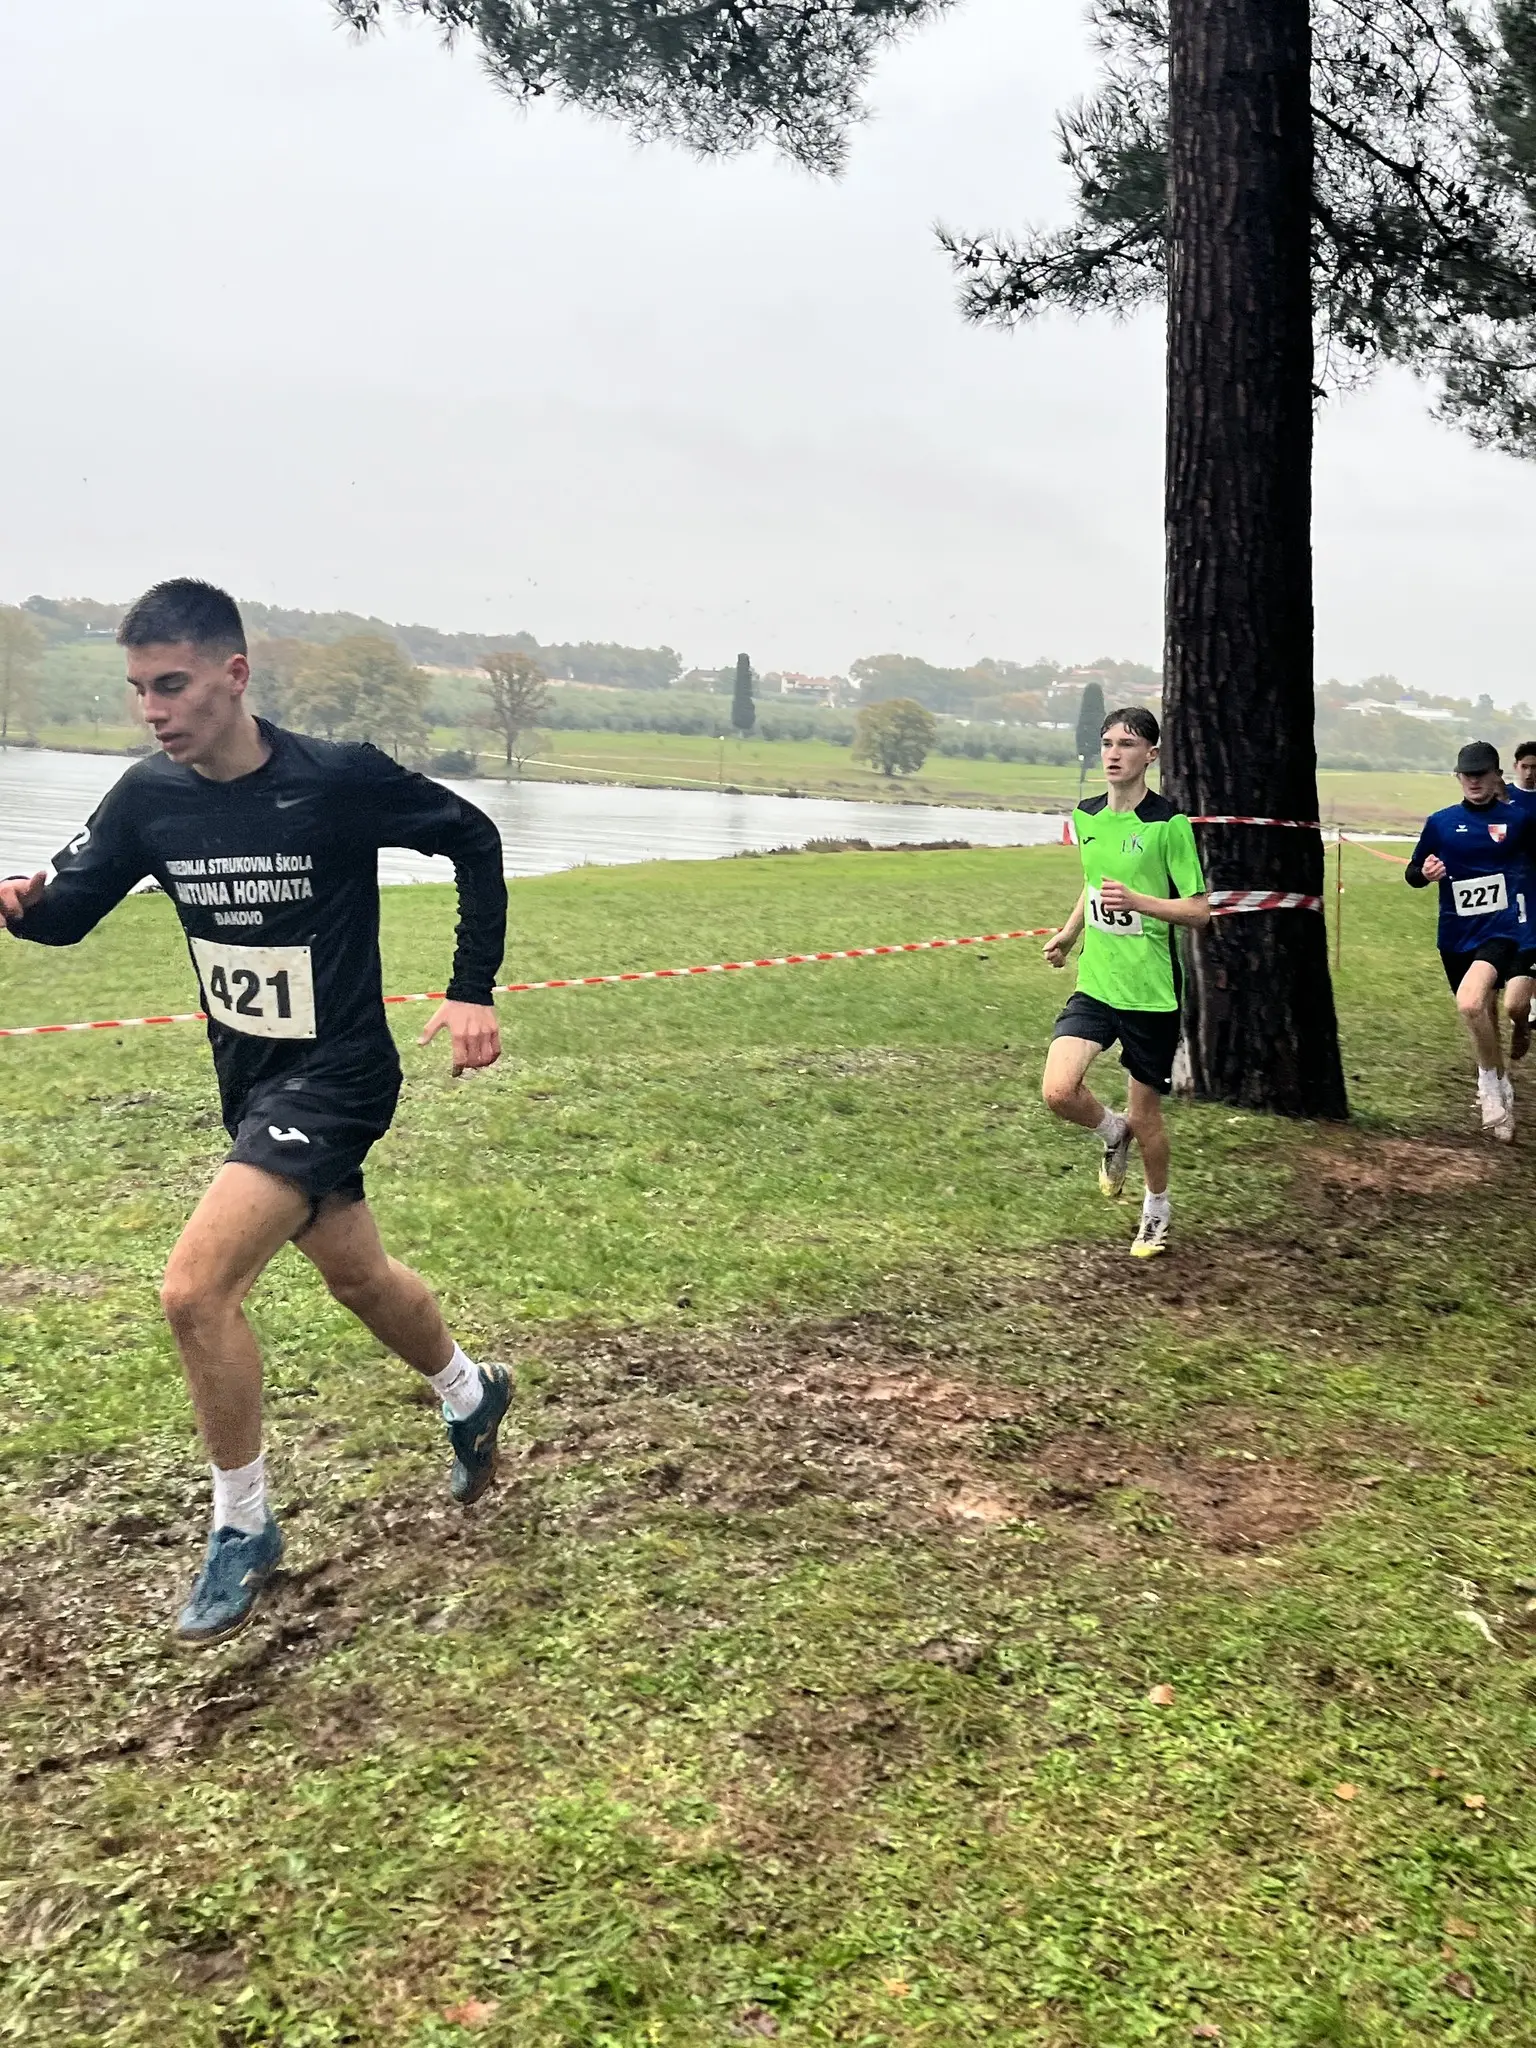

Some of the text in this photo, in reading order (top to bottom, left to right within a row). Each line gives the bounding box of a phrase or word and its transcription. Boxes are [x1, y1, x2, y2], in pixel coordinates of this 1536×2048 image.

[208, 856, 273, 875] STRUKOVNA
[275, 853, 313, 872] ŠKOLA
[233, 877, 313, 904] HORVATA
[1459, 884, 1500, 908] 227
[1090, 899, 1133, 926] 193
[211, 965, 291, 1018] 421
